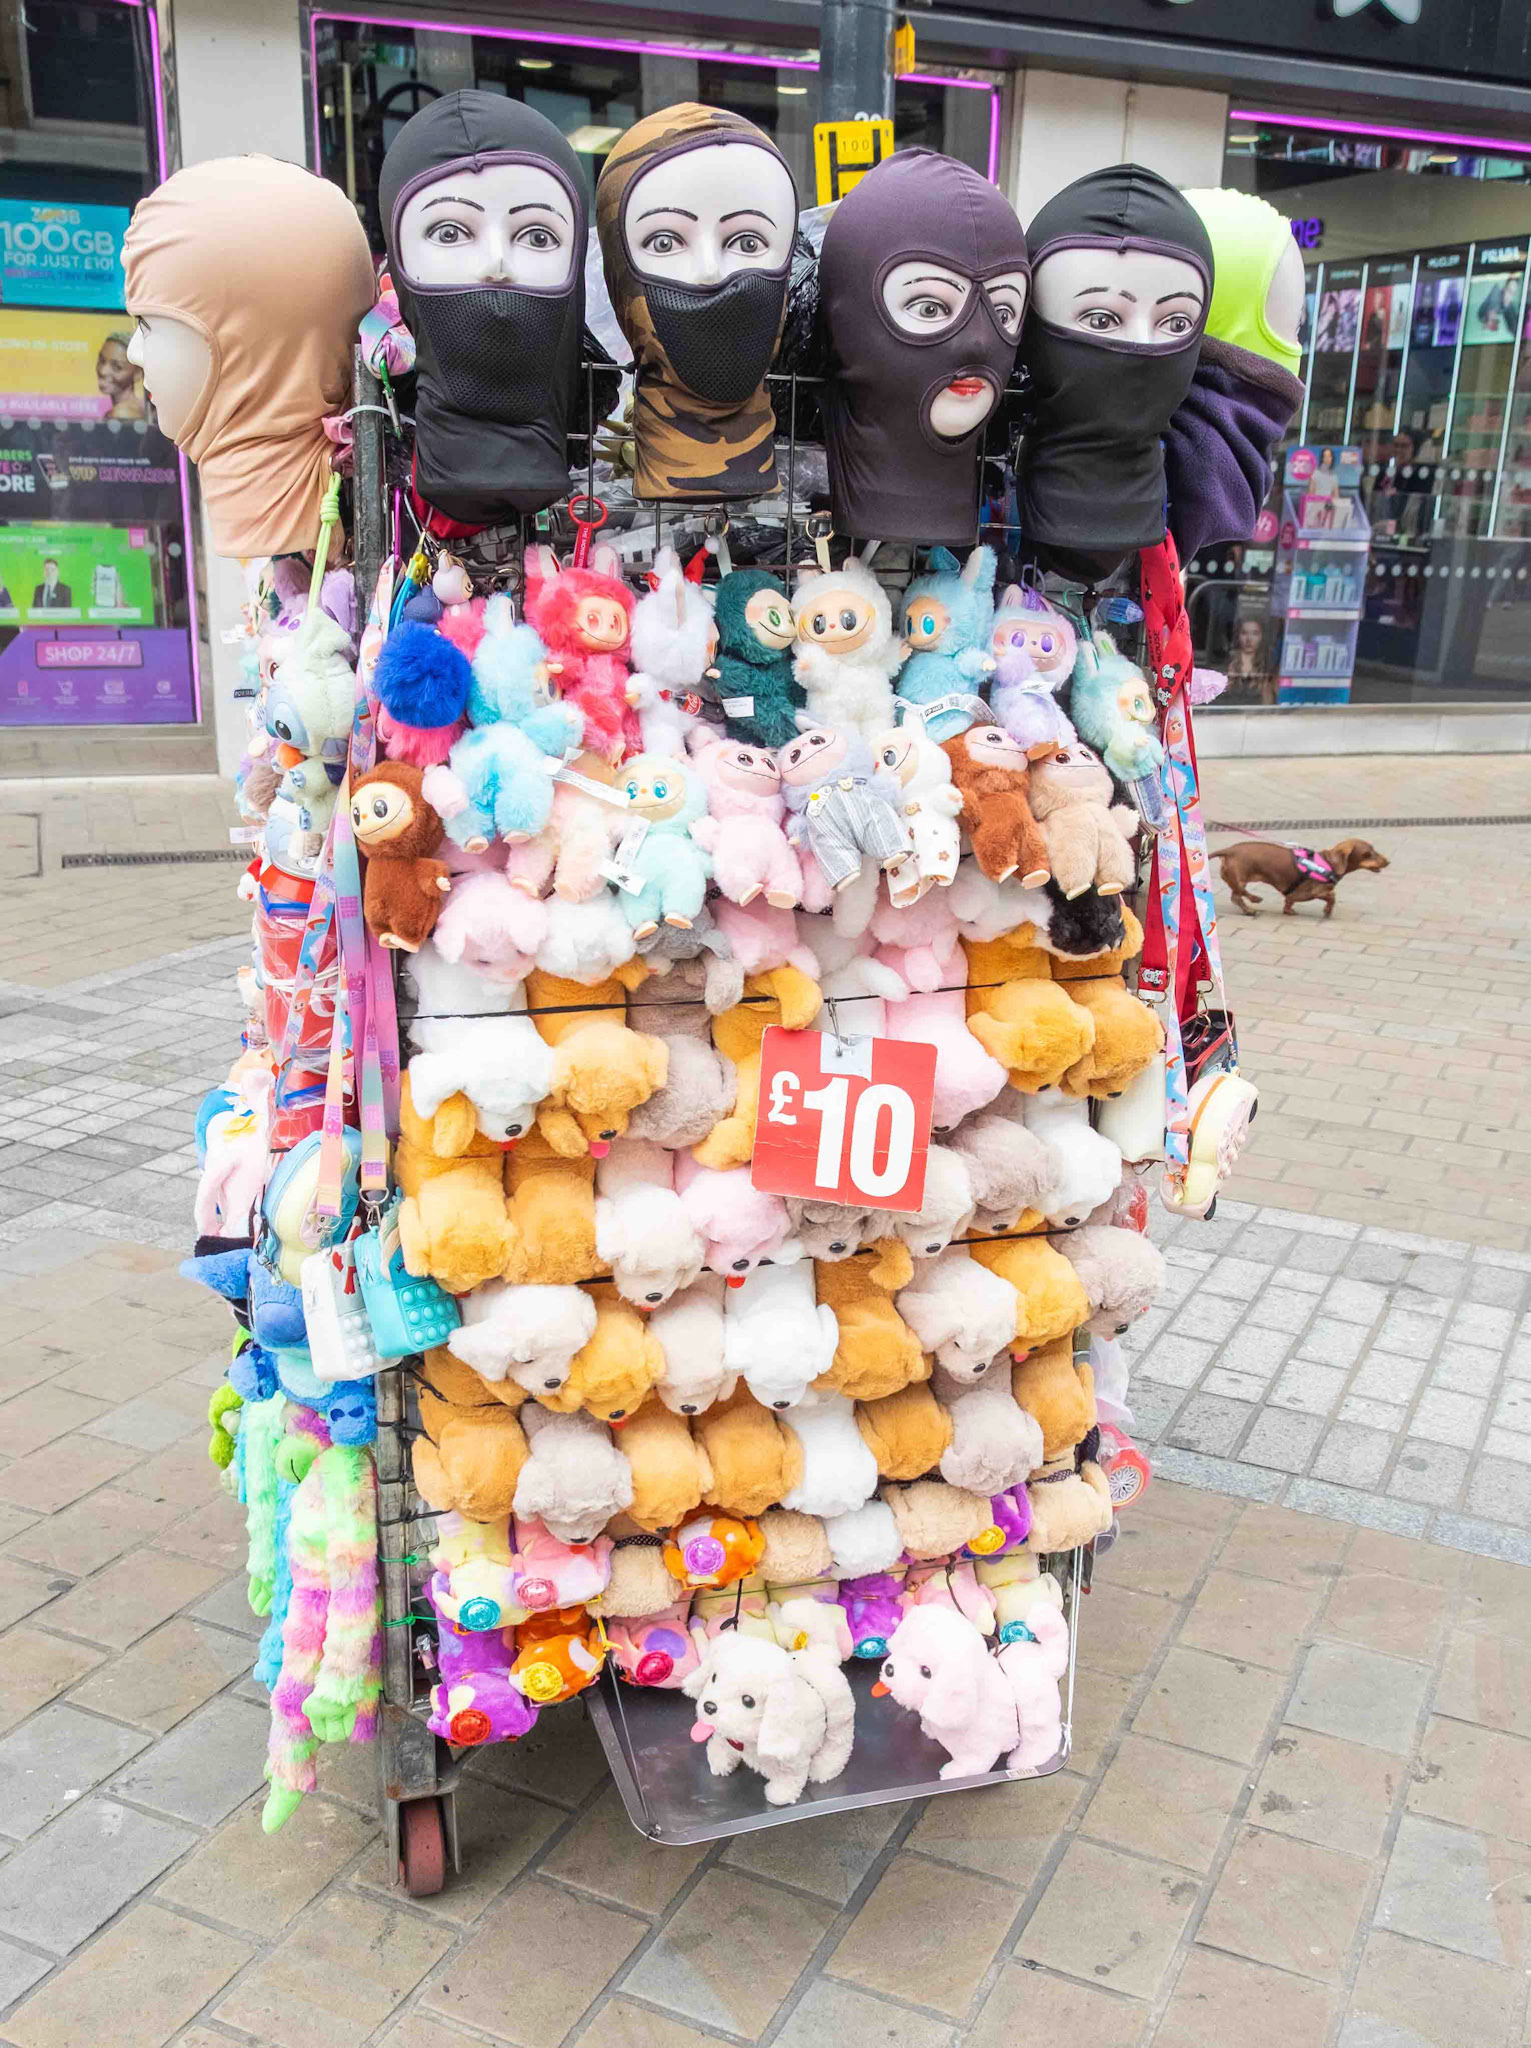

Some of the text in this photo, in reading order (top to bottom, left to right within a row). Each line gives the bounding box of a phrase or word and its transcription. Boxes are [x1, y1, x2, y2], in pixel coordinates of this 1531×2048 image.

[841, 140, 870, 153] 100
[0, 220, 115, 255] 100GB
[4, 251, 37, 266] FOR
[40, 253, 80, 269] JUST
[44, 645, 136, 662] SHOP 24/7
[767, 1070, 916, 1197] £10
